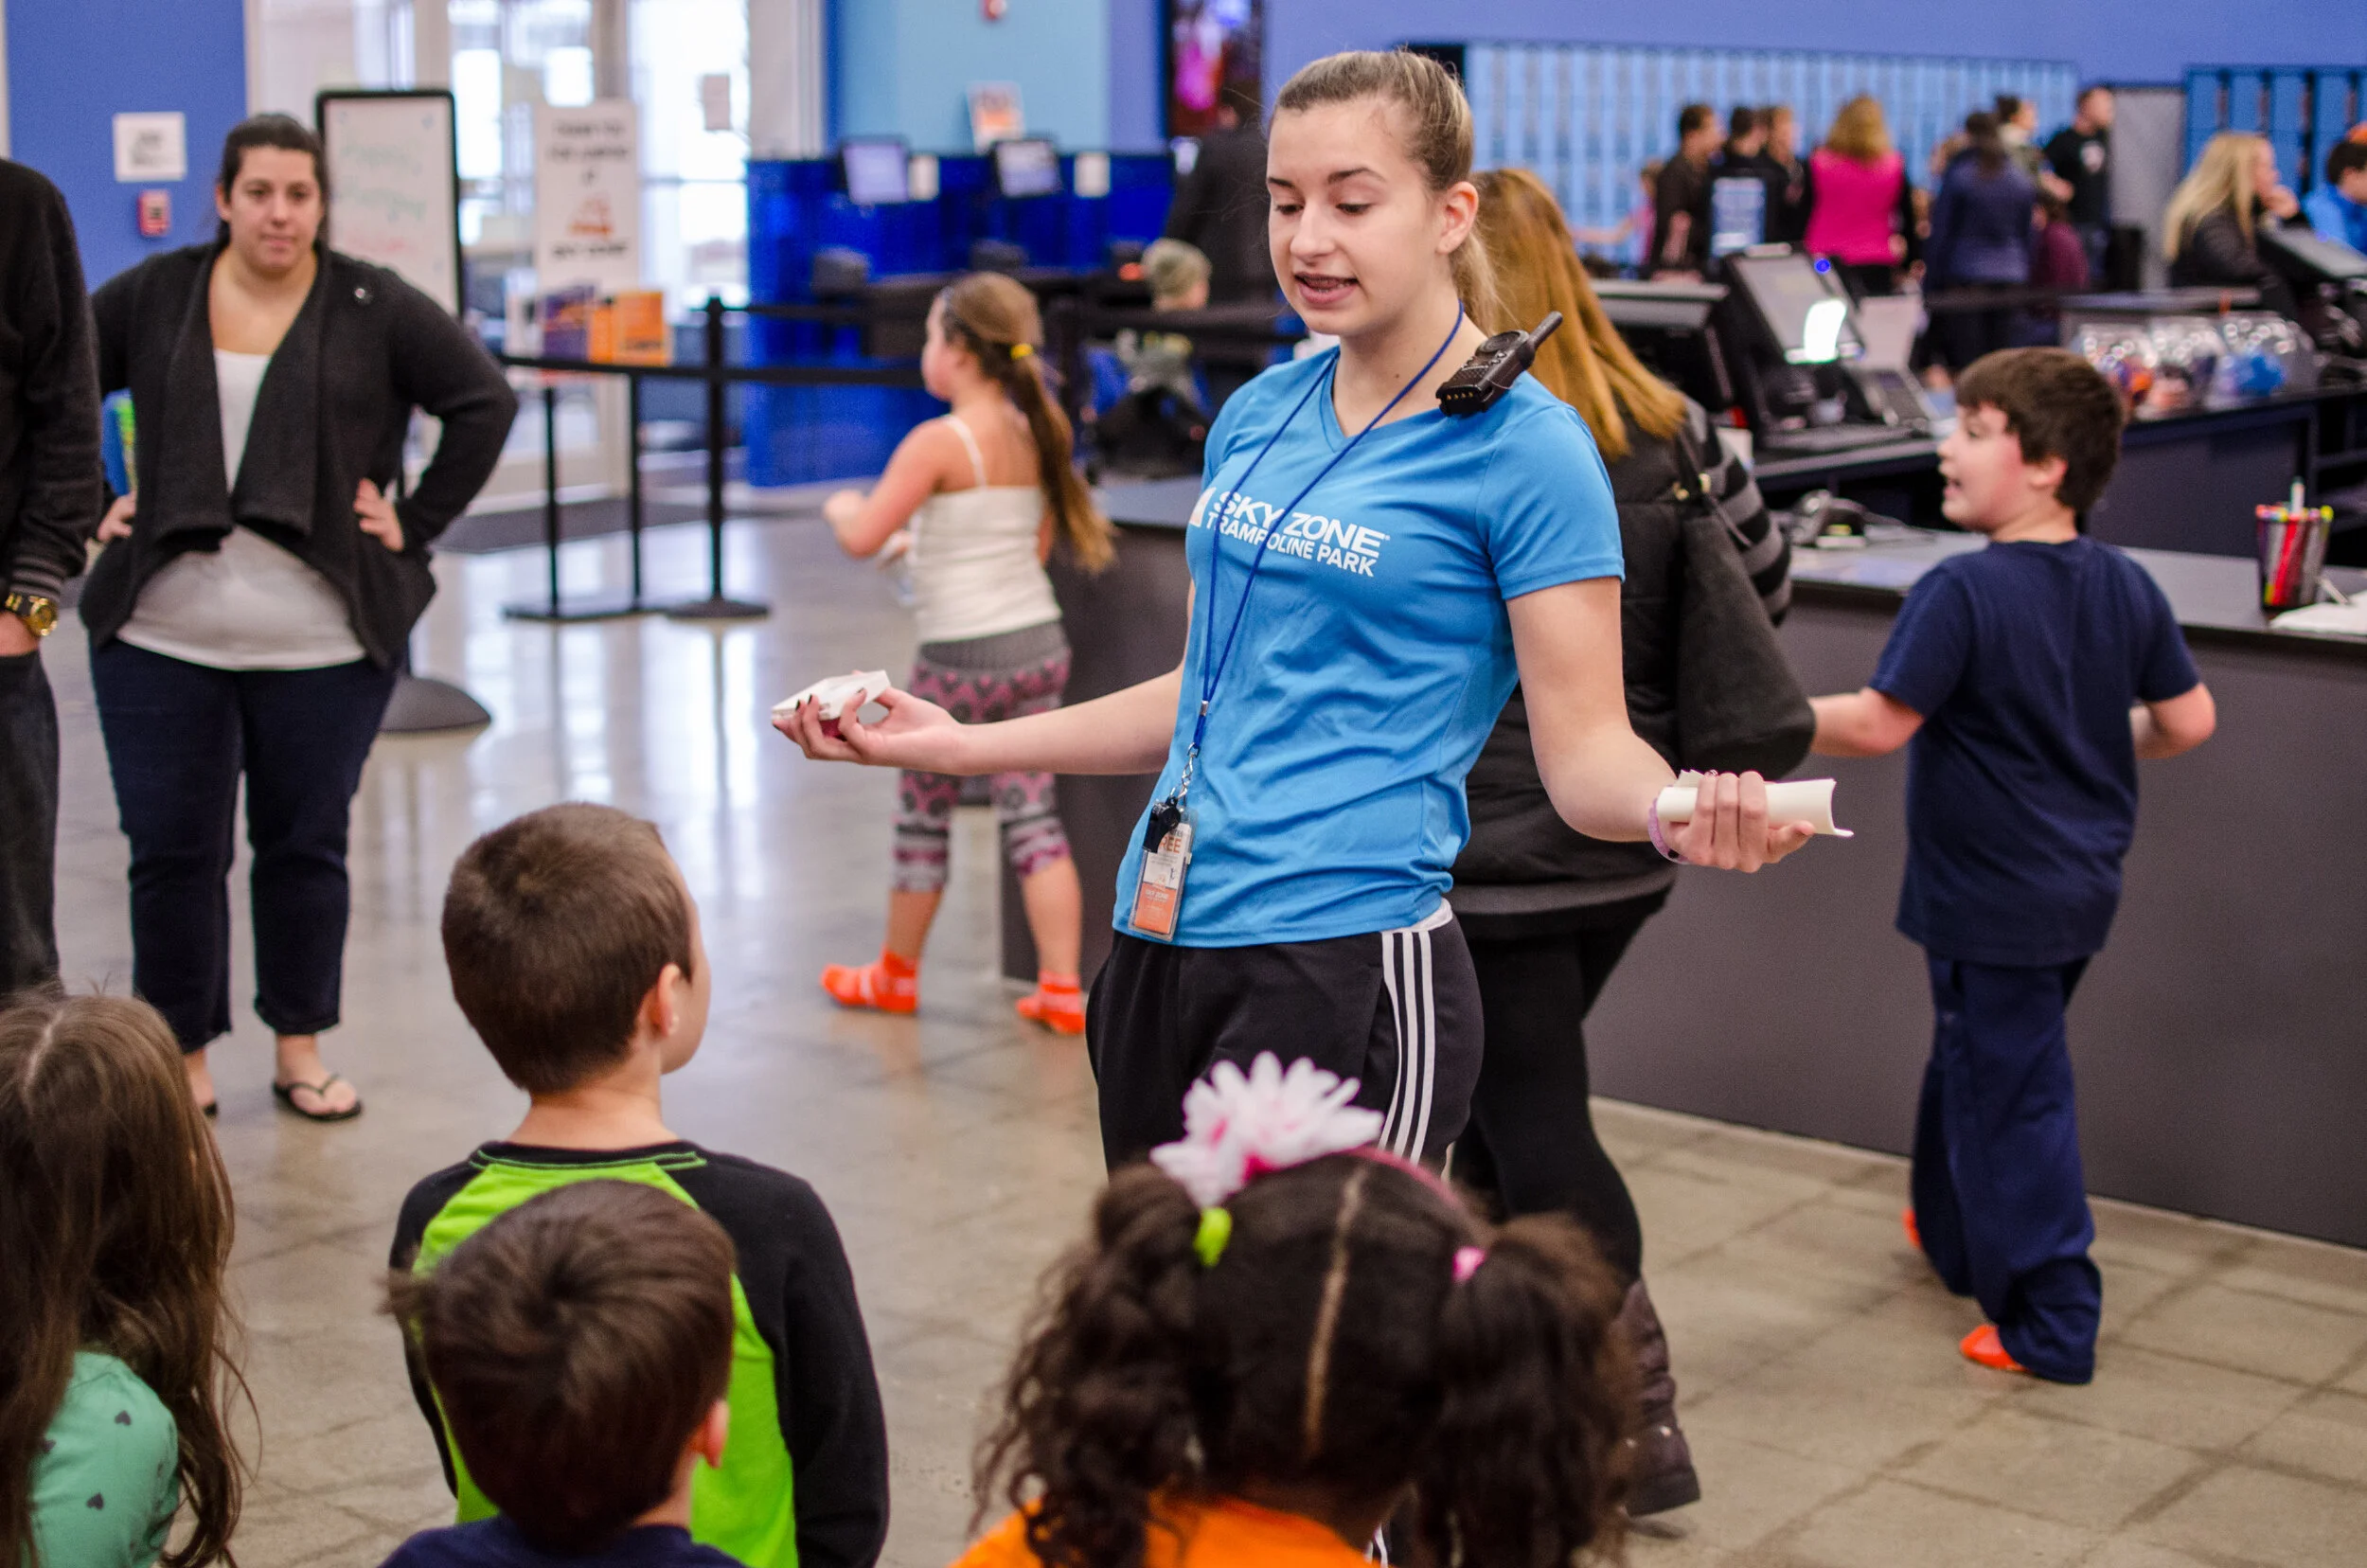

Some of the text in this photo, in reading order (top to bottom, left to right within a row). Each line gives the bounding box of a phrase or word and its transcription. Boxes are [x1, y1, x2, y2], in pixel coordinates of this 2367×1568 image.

[1206, 511, 1378, 578] TRAMPOLINE PARK
[1213, 490, 1386, 559] SKY ZONE
[1159, 834, 1183, 854] REE
